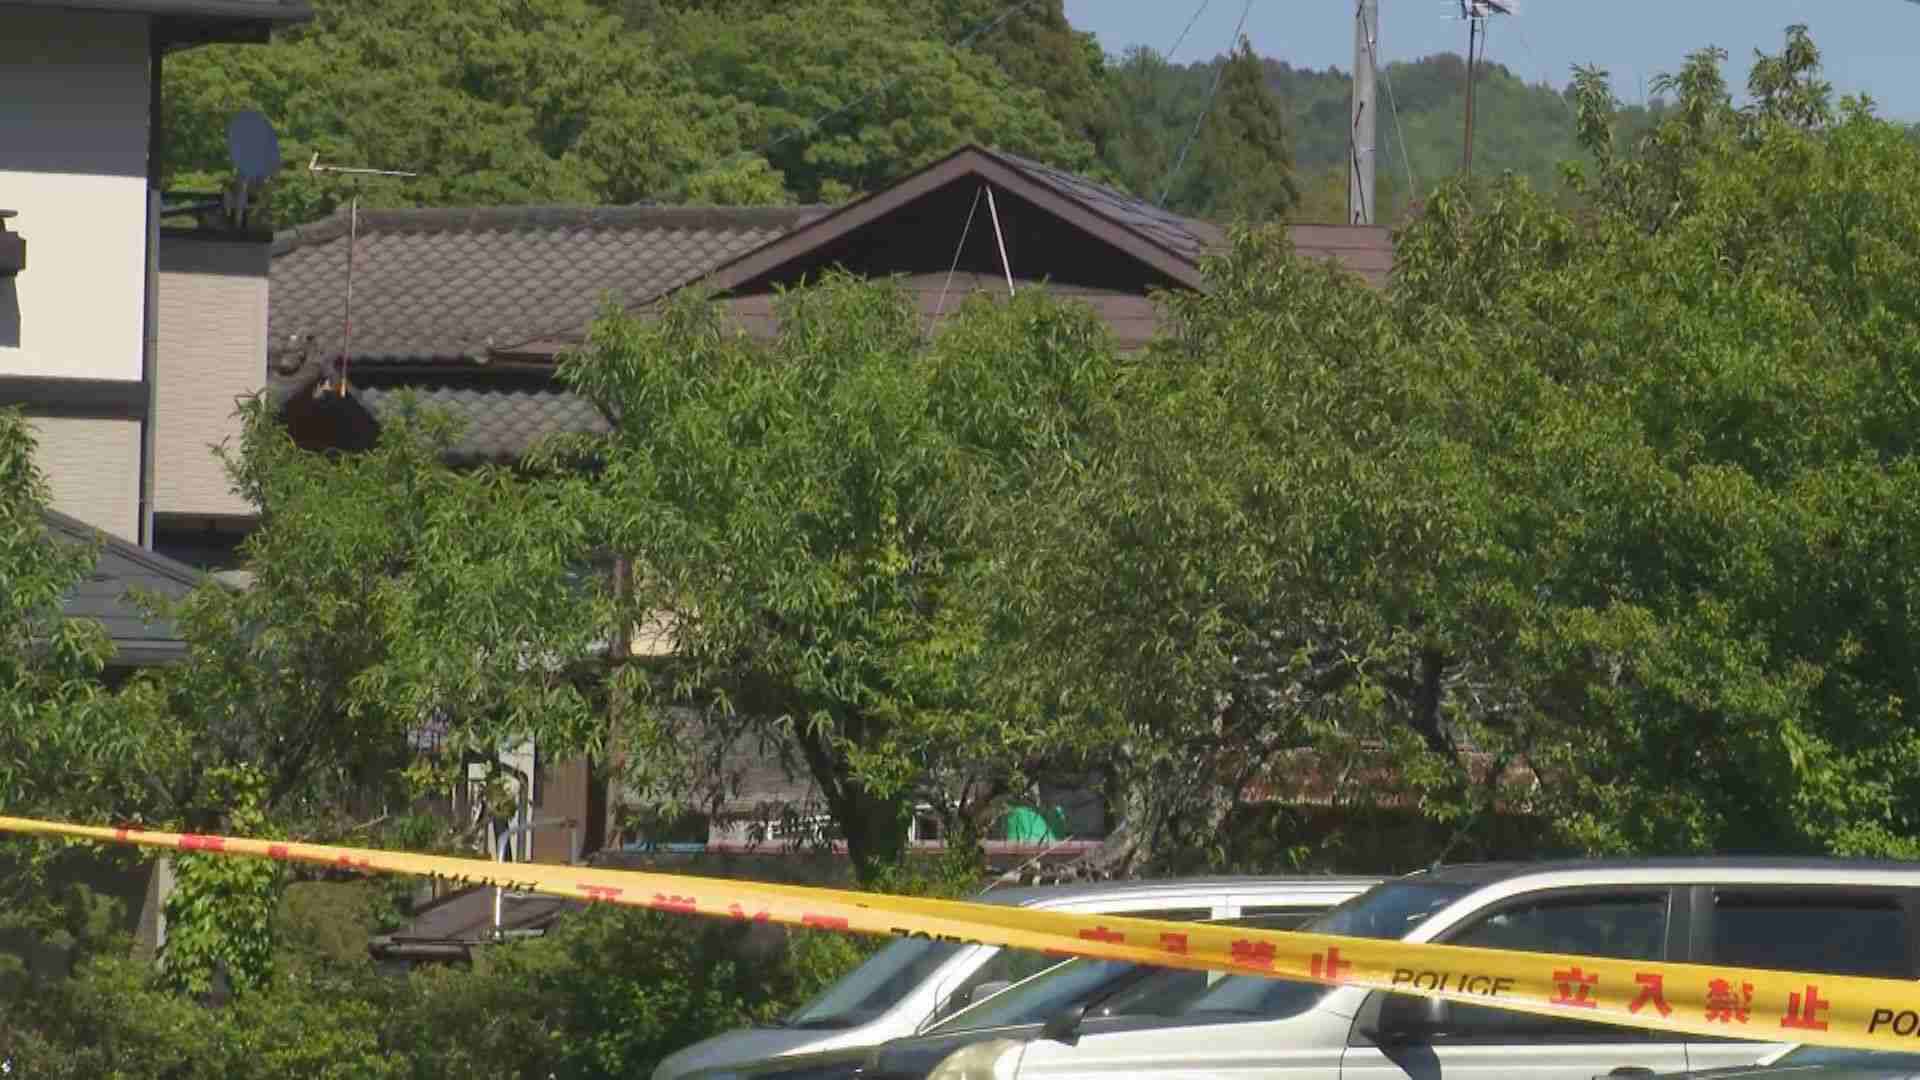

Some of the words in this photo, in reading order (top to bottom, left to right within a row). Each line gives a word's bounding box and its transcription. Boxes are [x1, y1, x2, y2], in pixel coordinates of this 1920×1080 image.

[1392, 968, 1516, 997] POLICE
[1550, 966, 1830, 1032] 立入禁止
[1867, 1008, 1920, 1038] PO
